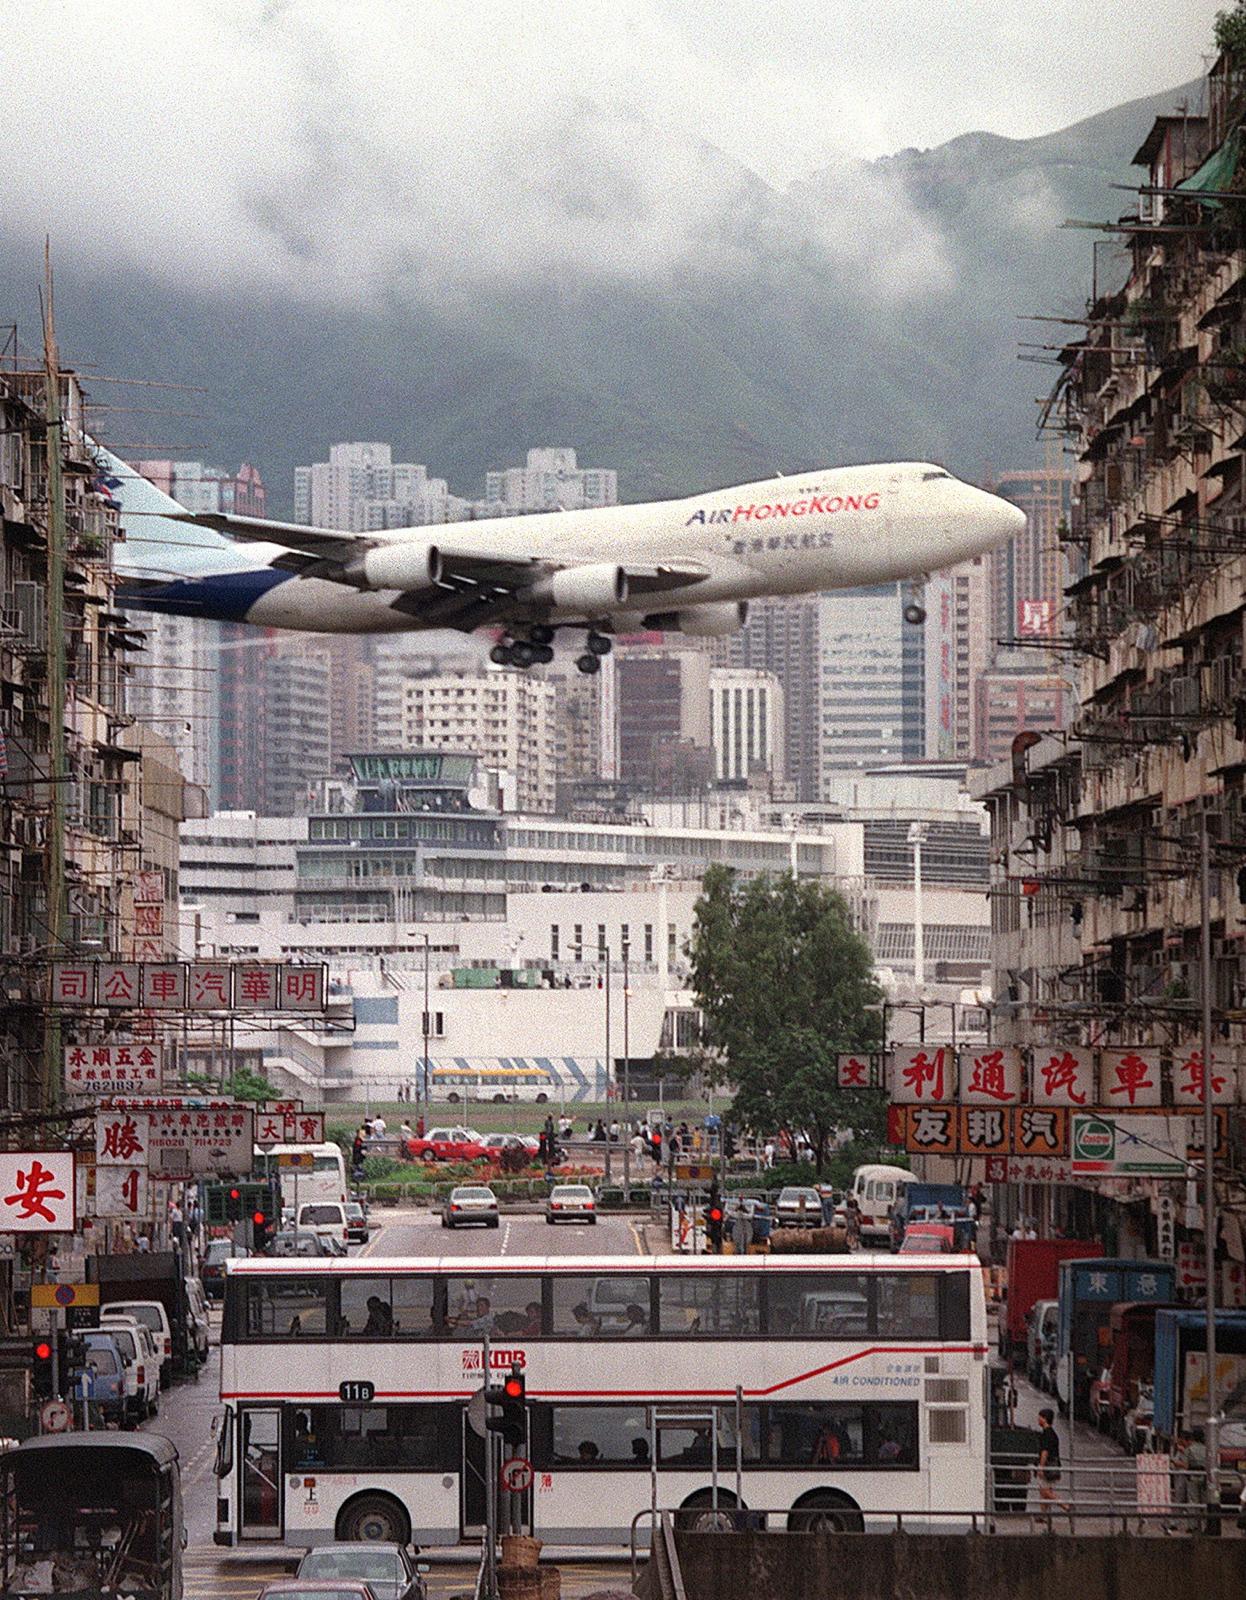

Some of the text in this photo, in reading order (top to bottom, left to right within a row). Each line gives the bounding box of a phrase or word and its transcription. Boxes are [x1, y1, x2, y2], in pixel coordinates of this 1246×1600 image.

[68, 1046, 157, 1067] 永順五金
[83, 1081, 144, 1091] 7621837
[2, 1160, 65, 1224] 安
[482, 1350, 527, 1369] KMB
[833, 1376, 920, 1386] AIR CONDITIONED
[343, 1382, 370, 1400] 11B
